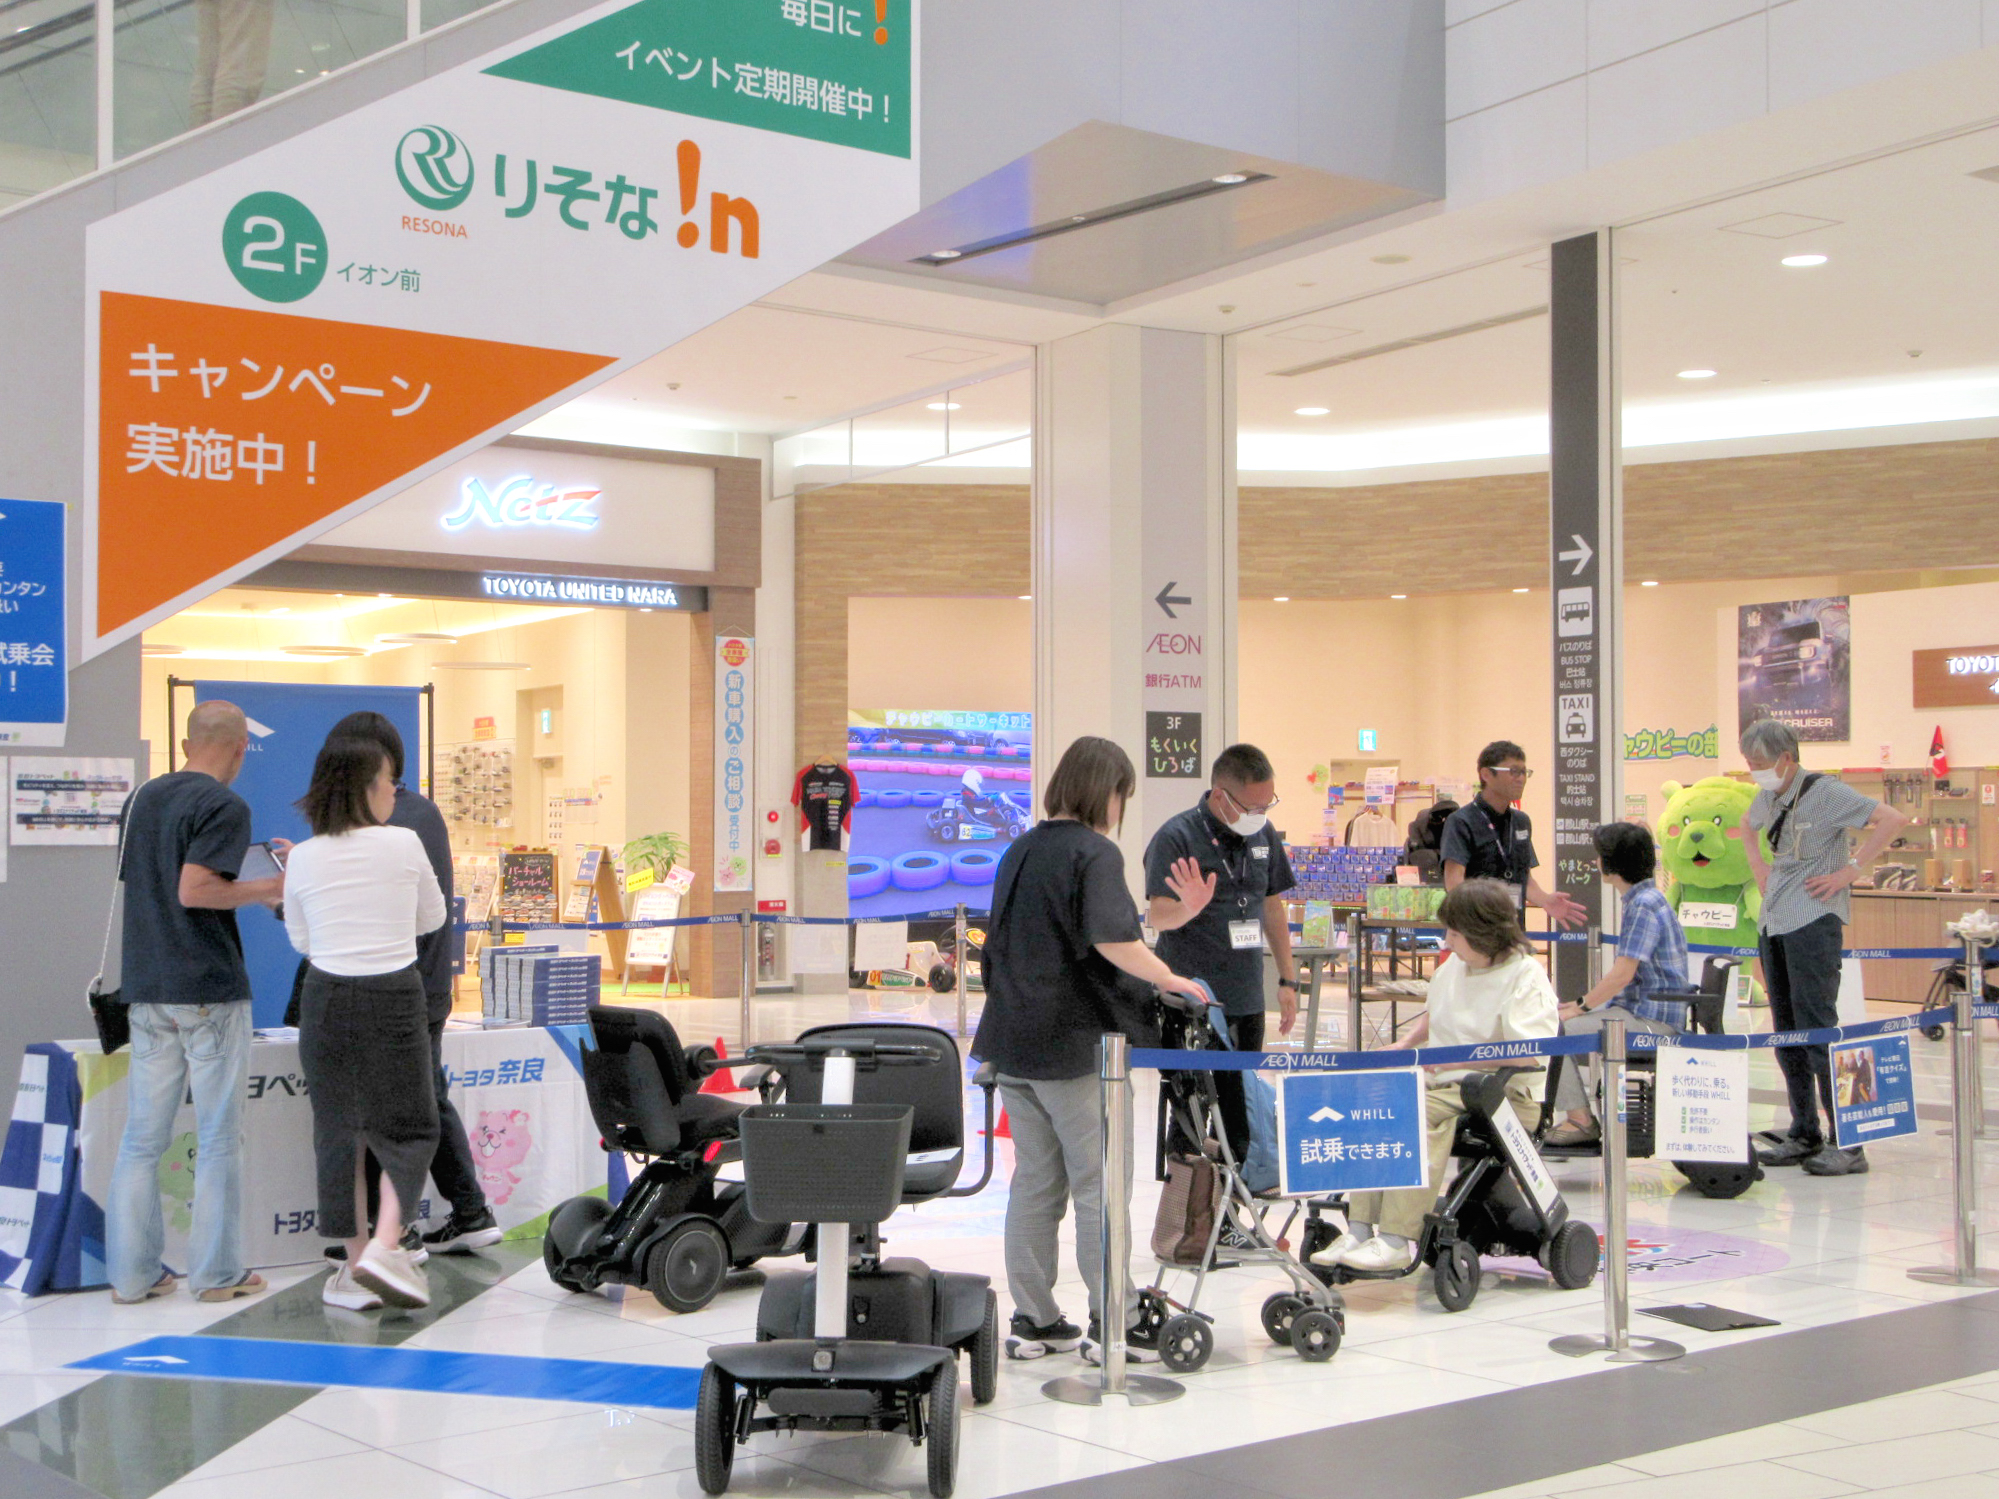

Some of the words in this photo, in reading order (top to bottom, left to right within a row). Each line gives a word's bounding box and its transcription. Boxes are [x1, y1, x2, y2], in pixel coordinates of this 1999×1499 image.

[615, 40, 890, 123] イベント定期開催中！
[401, 215, 469, 239] RESONA
[242, 215, 318, 275] 2F
[336, 262, 421, 293] イオン前
[128, 343, 432, 417] キャンペーン
[126, 422, 317, 484] 実施中！
[443, 476, 602, 528] Netz
[483, 577, 557, 597] TOYOTA
[559, 581, 625, 602] UNITED
[627, 585, 678, 605] NARA
[1559, 641, 1593, 652] バスのりば
[1561, 656, 1574, 666] BUS
[1574, 655, 1592, 665] STOP
[1145, 673, 1201, 689] 銀行ATM
[1561, 697, 1590, 710] TAXI
[1166, 716, 1182, 730] 3F
[1150, 736, 1198, 753] もくいく
[1153, 757, 1197, 773] ひろば
[1566, 759, 1587, 769] のりば
[1559, 773, 1574, 783] TAXI
[1574, 773, 1595, 783] STAND
[1565, 873, 1591, 885] パーク
[1235, 934, 1257, 942] STAFF
[1868, 950, 1891, 958] MALL
[1786, 1032, 1809, 1044] MALL
[1506, 1042, 1543, 1057] MALL
[1301, 1055, 1339, 1067] MALL
[1711, 1092, 1731, 1101] WHILL
[1350, 1108, 1395, 1120] WHILL
[1301, 1136, 1412, 1165] 試乗できます。
